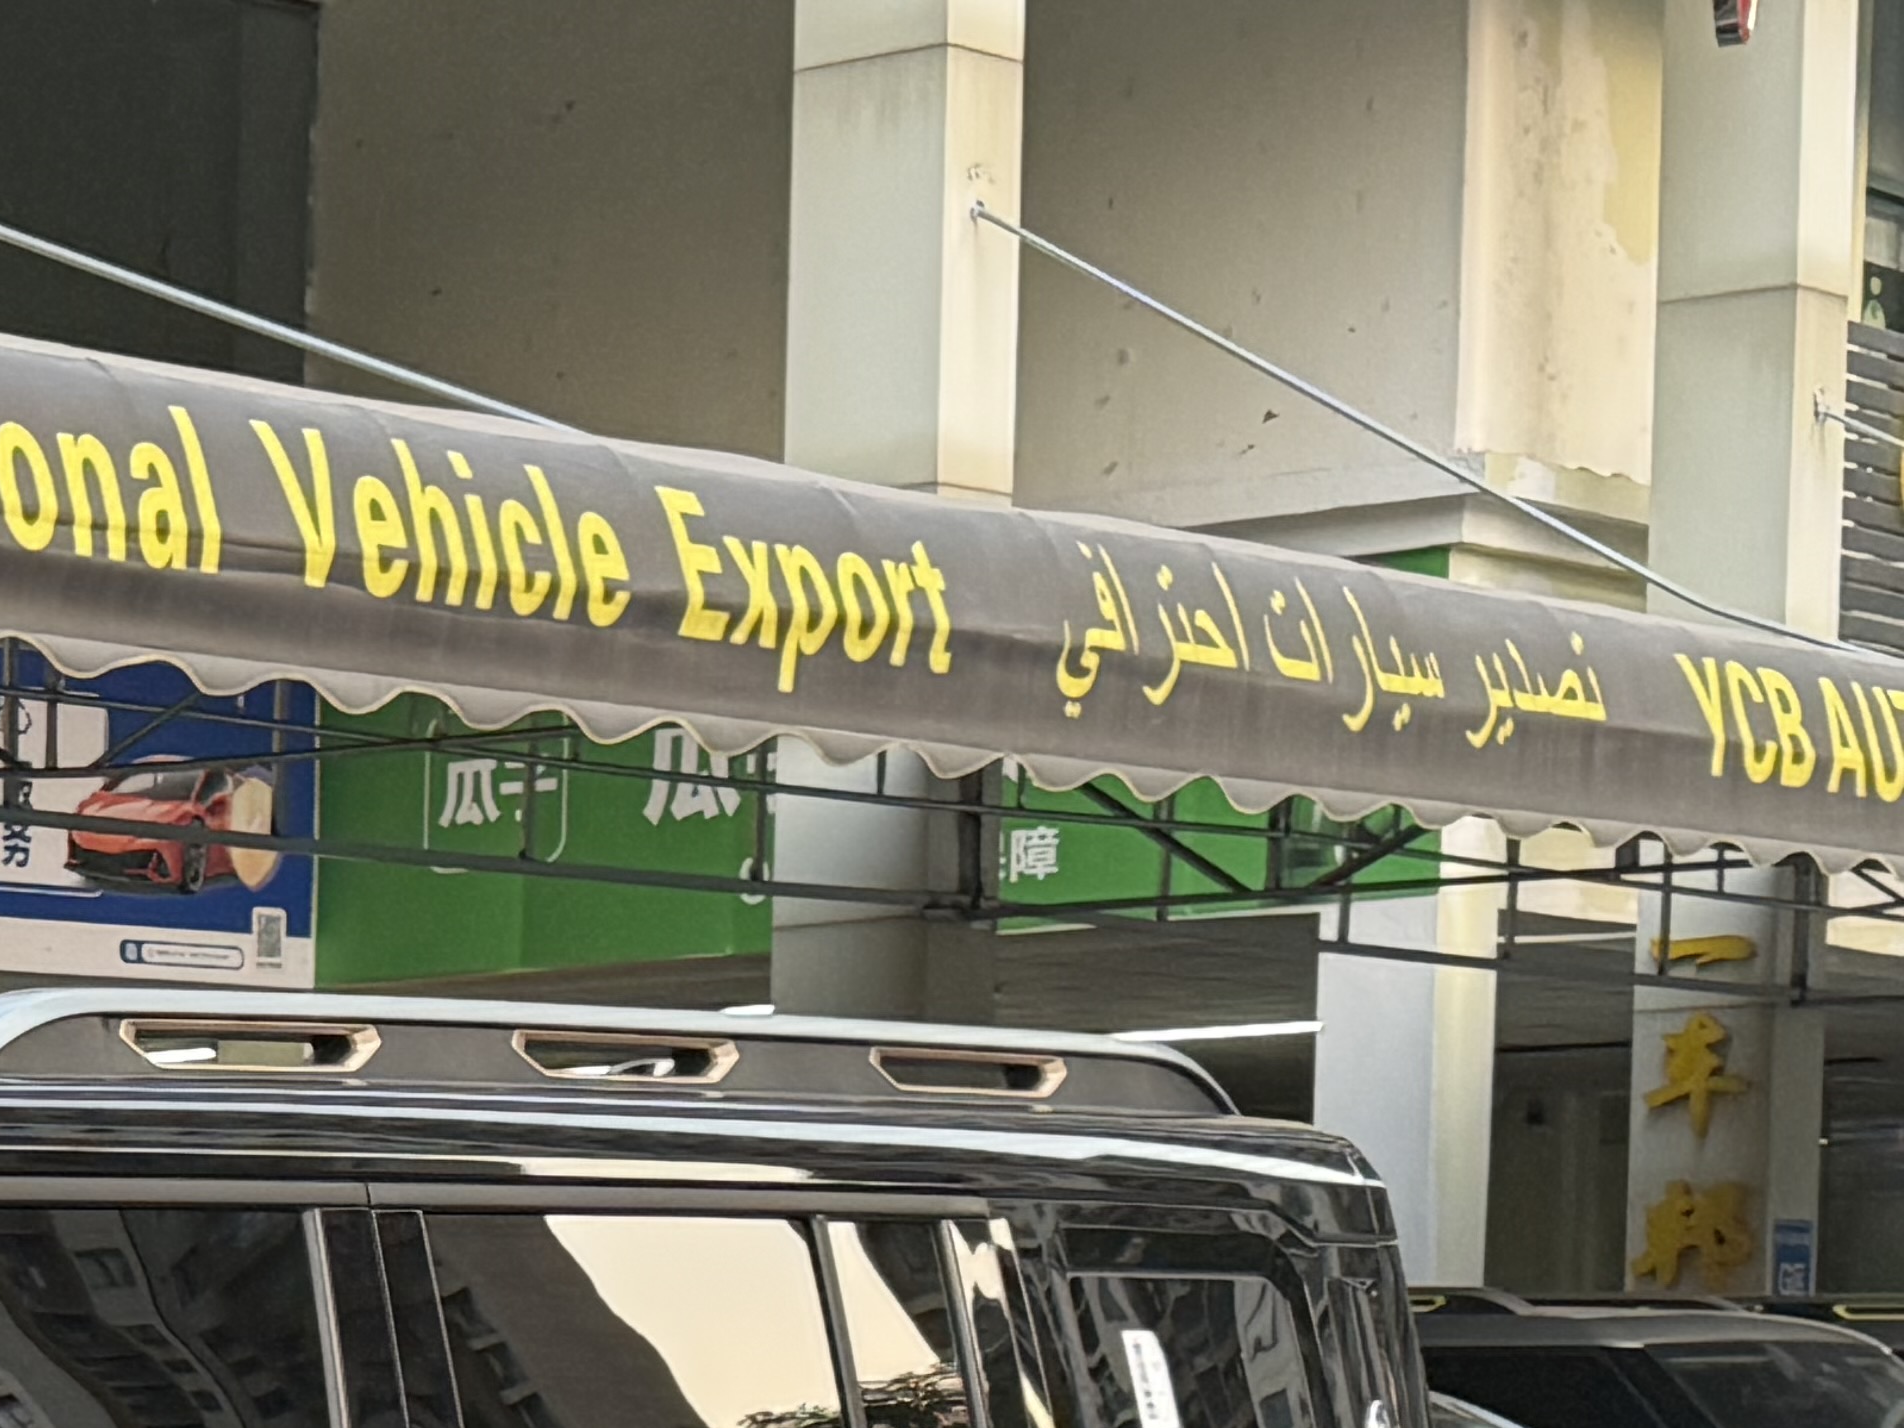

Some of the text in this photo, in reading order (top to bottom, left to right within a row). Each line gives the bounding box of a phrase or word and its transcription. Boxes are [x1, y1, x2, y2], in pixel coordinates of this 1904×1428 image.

[249, 419, 633, 629] Vehicle
[654, 484, 955, 694] Export
[1673, 653, 1904, 803] YCB AU
[998, 825, 1061, 883] 障
